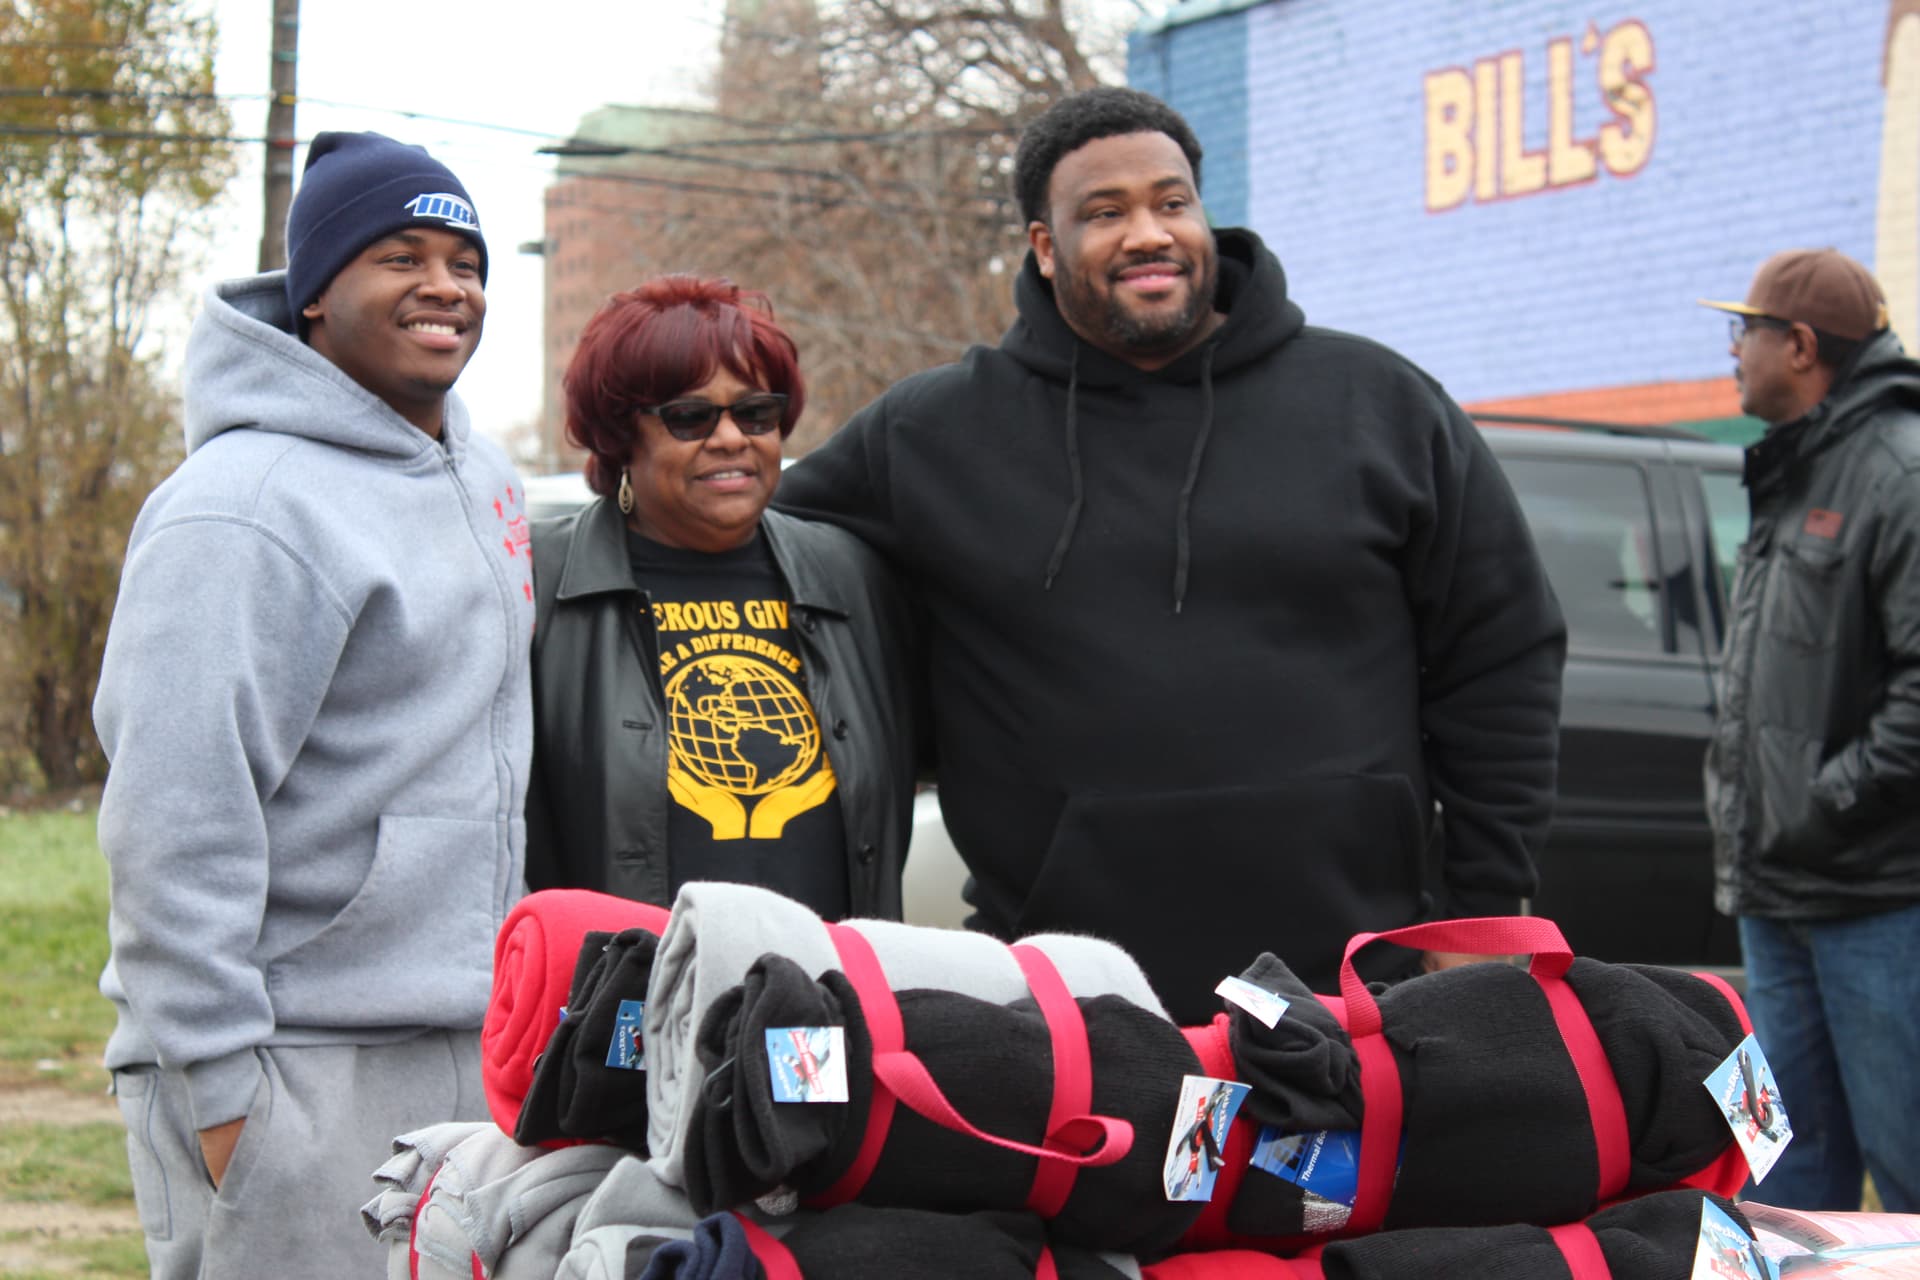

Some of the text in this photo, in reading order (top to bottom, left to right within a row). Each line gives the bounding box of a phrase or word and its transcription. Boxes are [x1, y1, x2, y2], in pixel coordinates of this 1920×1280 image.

[1423, 16, 1657, 214] BILL'S
[676, 643, 693, 660] A
[689, 633, 801, 674] DIFFERENCE
[1301, 1145, 1322, 1182] Thermal
